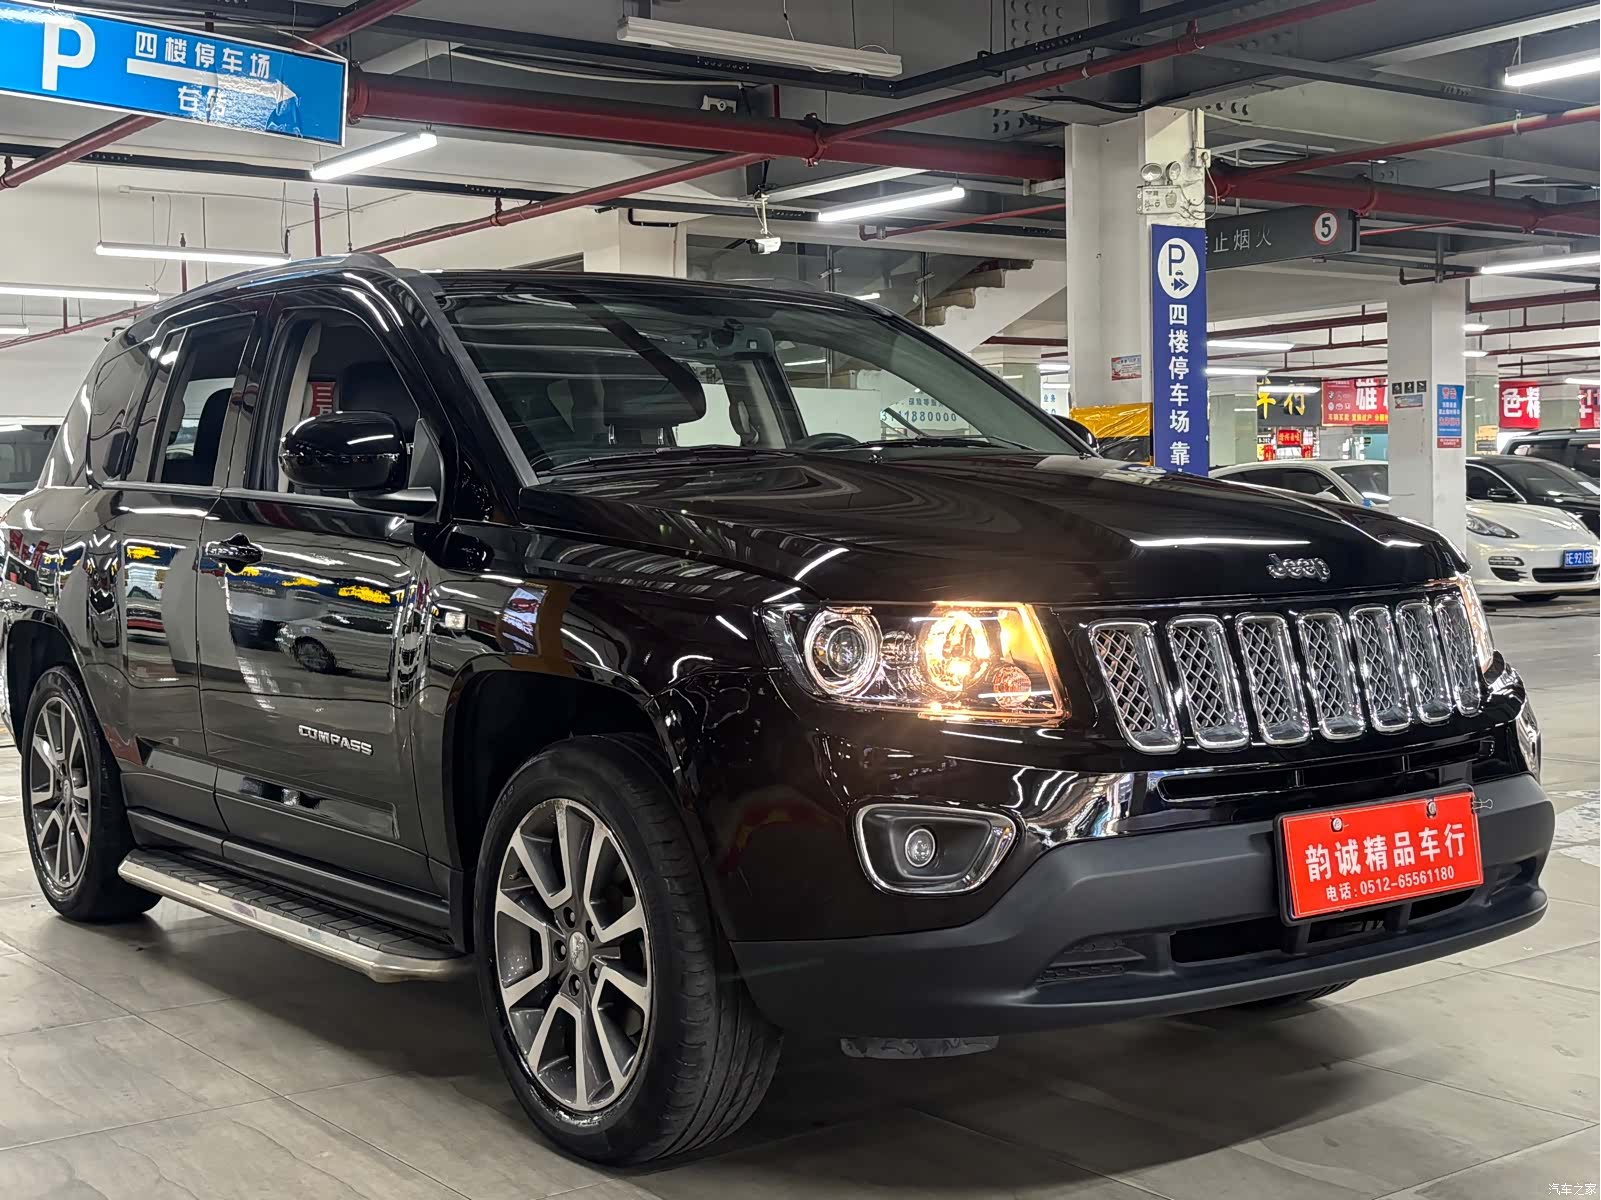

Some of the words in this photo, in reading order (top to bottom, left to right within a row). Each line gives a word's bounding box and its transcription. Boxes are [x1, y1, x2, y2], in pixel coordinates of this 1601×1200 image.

[42, 18, 96, 92] P
[135, 31, 270, 79] 四楼停车场
[1205, 227, 1272, 254] 止烟火
[1321, 217, 1332, 239] 5
[1168, 244, 1186, 276] P
[1266, 553, 1331, 583] Jeep
[298, 724, 374, 756] COMPASS
[1305, 823, 1466, 882] 韵诚精品车行
